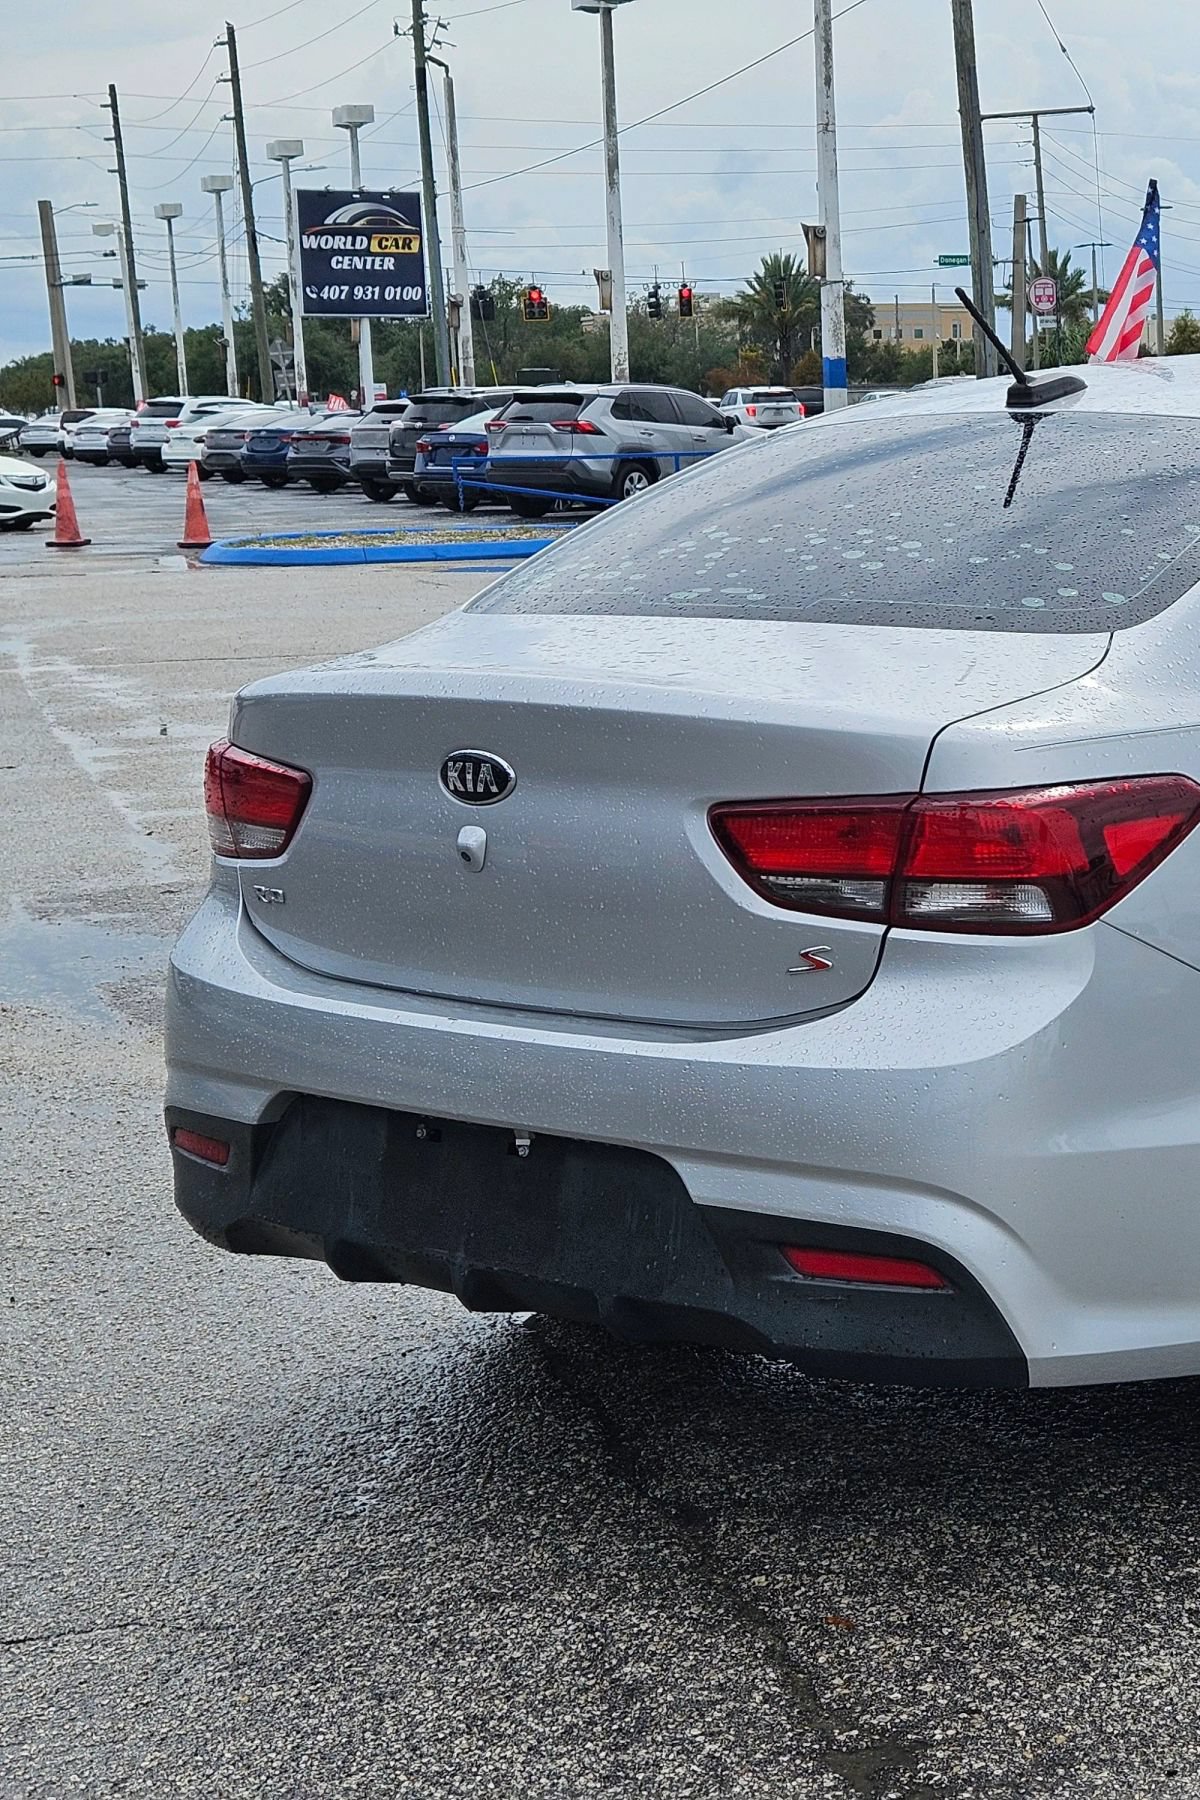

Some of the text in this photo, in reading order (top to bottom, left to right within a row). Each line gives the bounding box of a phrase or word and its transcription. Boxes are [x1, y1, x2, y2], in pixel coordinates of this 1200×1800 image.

[301, 234, 413, 251] WORLD CAR
[330, 255, 395, 270] CENTER
[940, 256, 967, 265] Donegan
[320, 285, 422, 301] 407 931 0100
[447, 761, 499, 793] KIA
